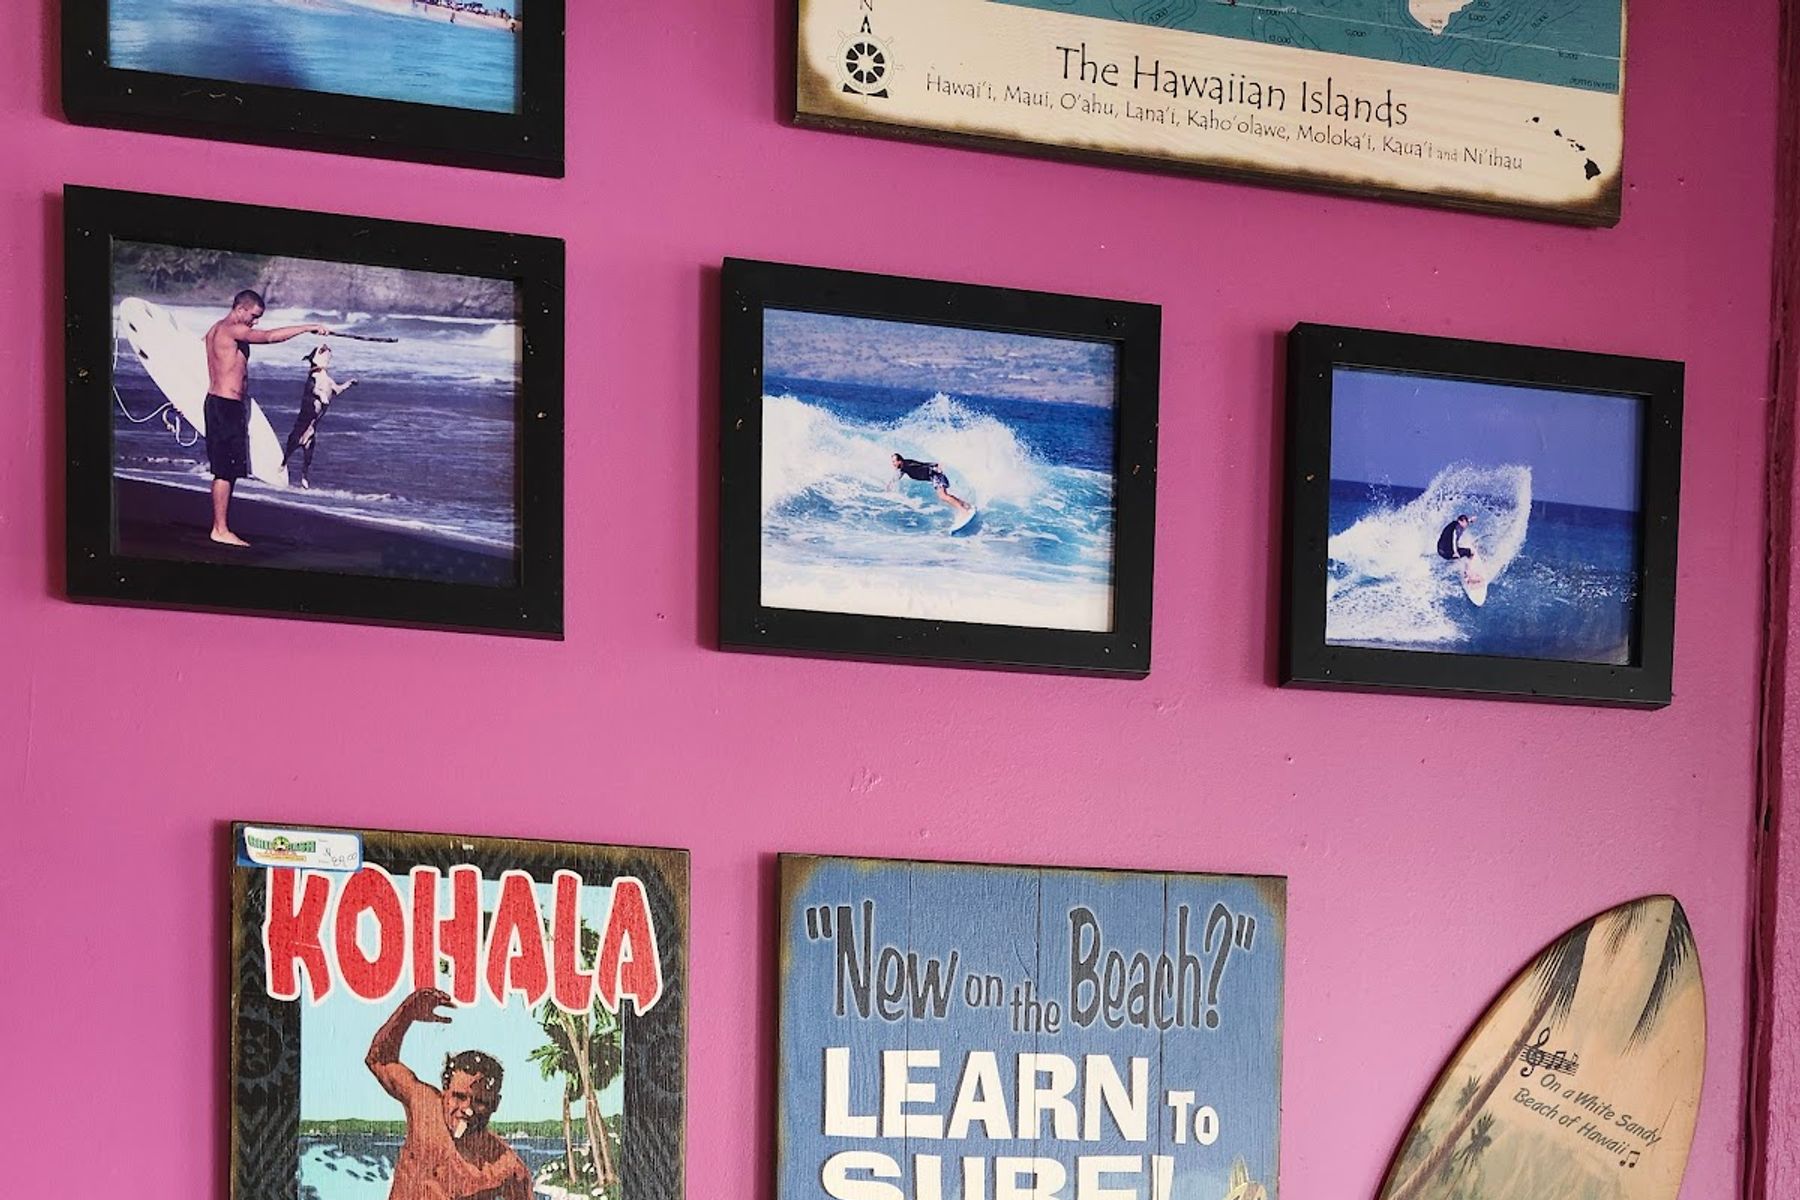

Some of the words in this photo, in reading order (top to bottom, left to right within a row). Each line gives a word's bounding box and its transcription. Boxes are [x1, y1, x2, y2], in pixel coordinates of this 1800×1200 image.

[1003, 85, 1053, 109] Maui,
[1436, 149, 1458, 162] and
[1056, 42, 1119, 87] The
[1133, 55, 1286, 112] Hawaiian
[1301, 77, 1408, 128] Islands
[262, 862, 663, 1016] KOHALA
[964, 972, 1004, 1009] on
[1010, 980, 1061, 1034] the
[823, 1046, 1150, 1142] LEARN
[1513, 1087, 1560, 1120] Beach
[1558, 1114, 1581, 1128] of
[1577, 1122, 1630, 1155] Hawaii
[1540, 1072, 1562, 1093] On
[1562, 1089, 1575, 1099] a
[1573, 1091, 1616, 1121] White
[1615, 1113, 1662, 1148] Sandy
